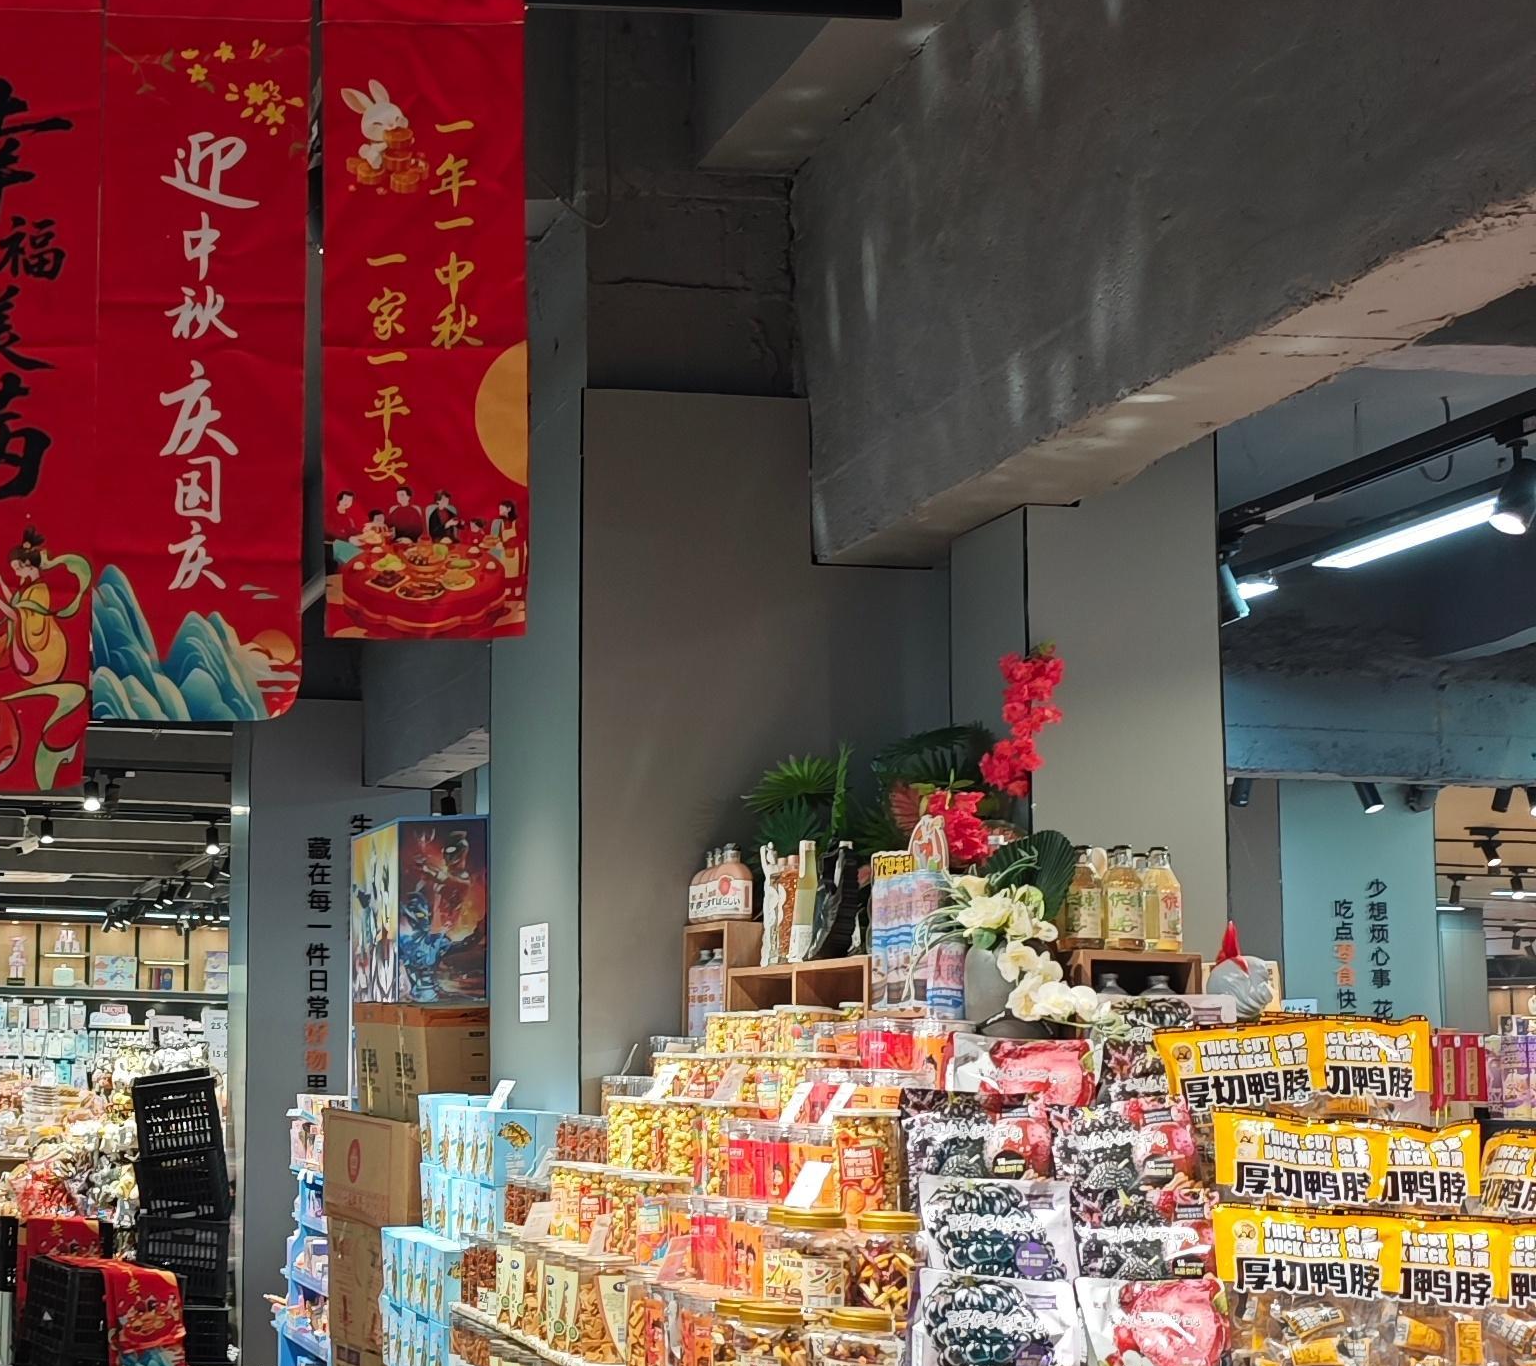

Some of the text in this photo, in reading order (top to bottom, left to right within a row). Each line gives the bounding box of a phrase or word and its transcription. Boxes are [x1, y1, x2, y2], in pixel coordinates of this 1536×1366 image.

[427, 118, 484, 350] 一年一中秋
[364, 253, 408, 485] 一家一平安
[305, 836, 332, 1092] 藏在每一件日常好物里
[1333, 898, 1358, 1014] 吃点零食快
[1365, 878, 1391, 988] 少想烦心事
[1180, 1066, 1312, 1108] 厚切鸭脖
[1235, 1161, 1370, 1202] 厚切鸭脖
[1235, 1256, 1380, 1299] 厚切鸭脖
